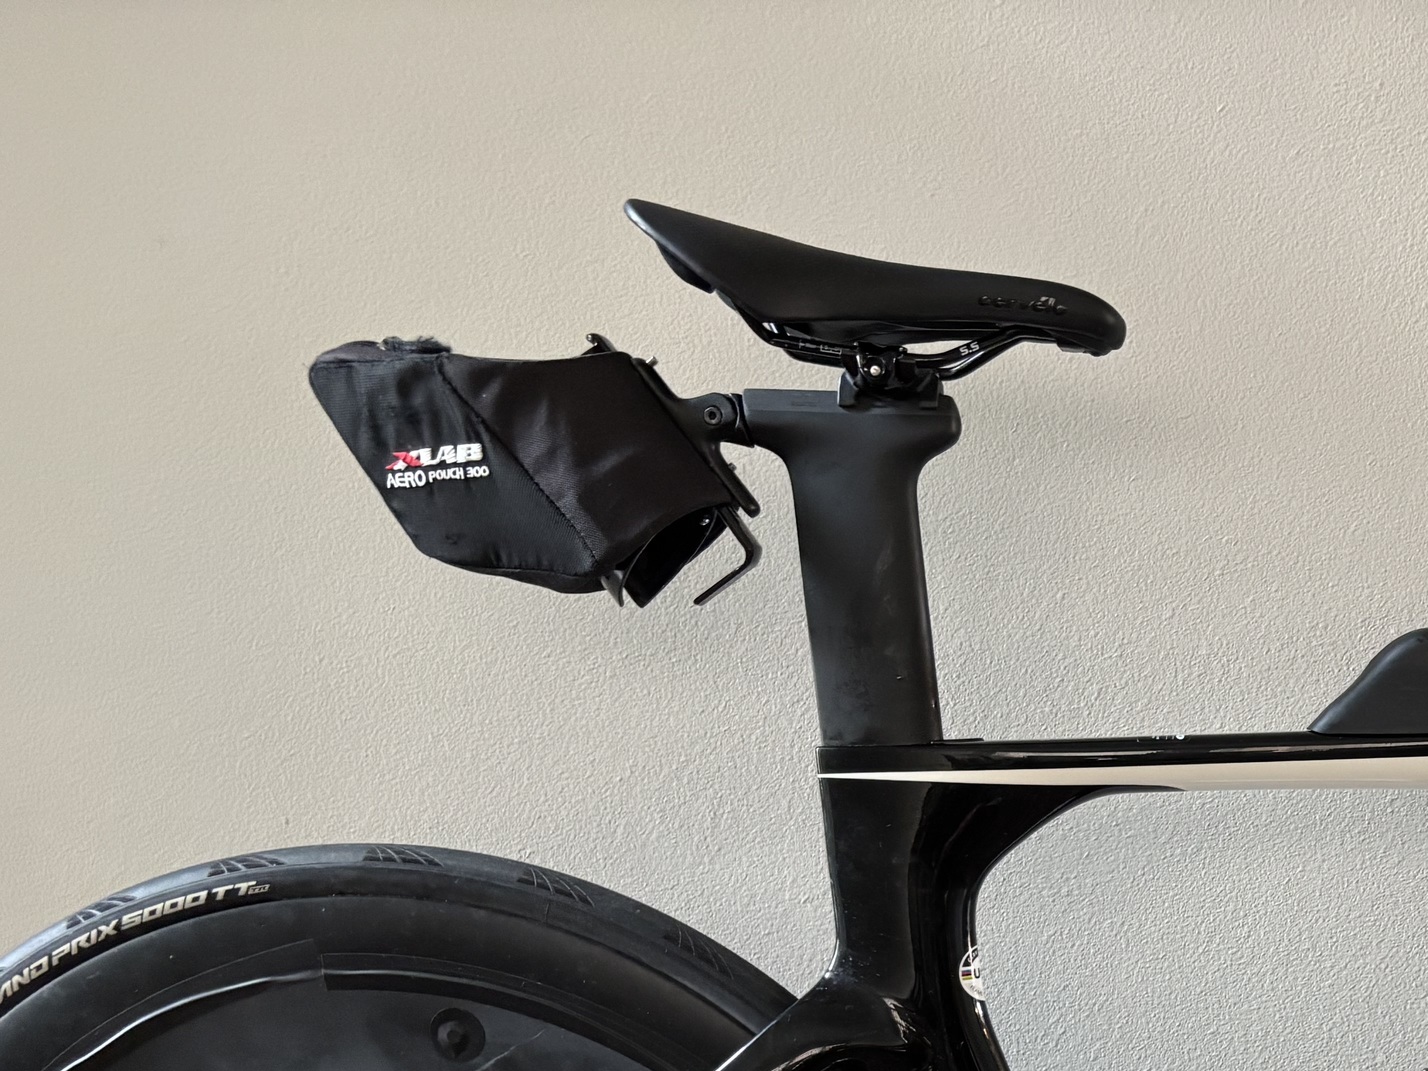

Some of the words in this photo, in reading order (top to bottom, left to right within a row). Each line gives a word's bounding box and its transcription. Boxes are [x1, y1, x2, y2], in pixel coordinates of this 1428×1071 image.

[386, 470, 427, 489] AERO
[428, 467, 465, 483] POUCH
[466, 465, 490, 478] 300
[52, 919, 119, 967] PRIX
[121, 889, 208, 931] 5000
[212, 880, 257, 901] TT
